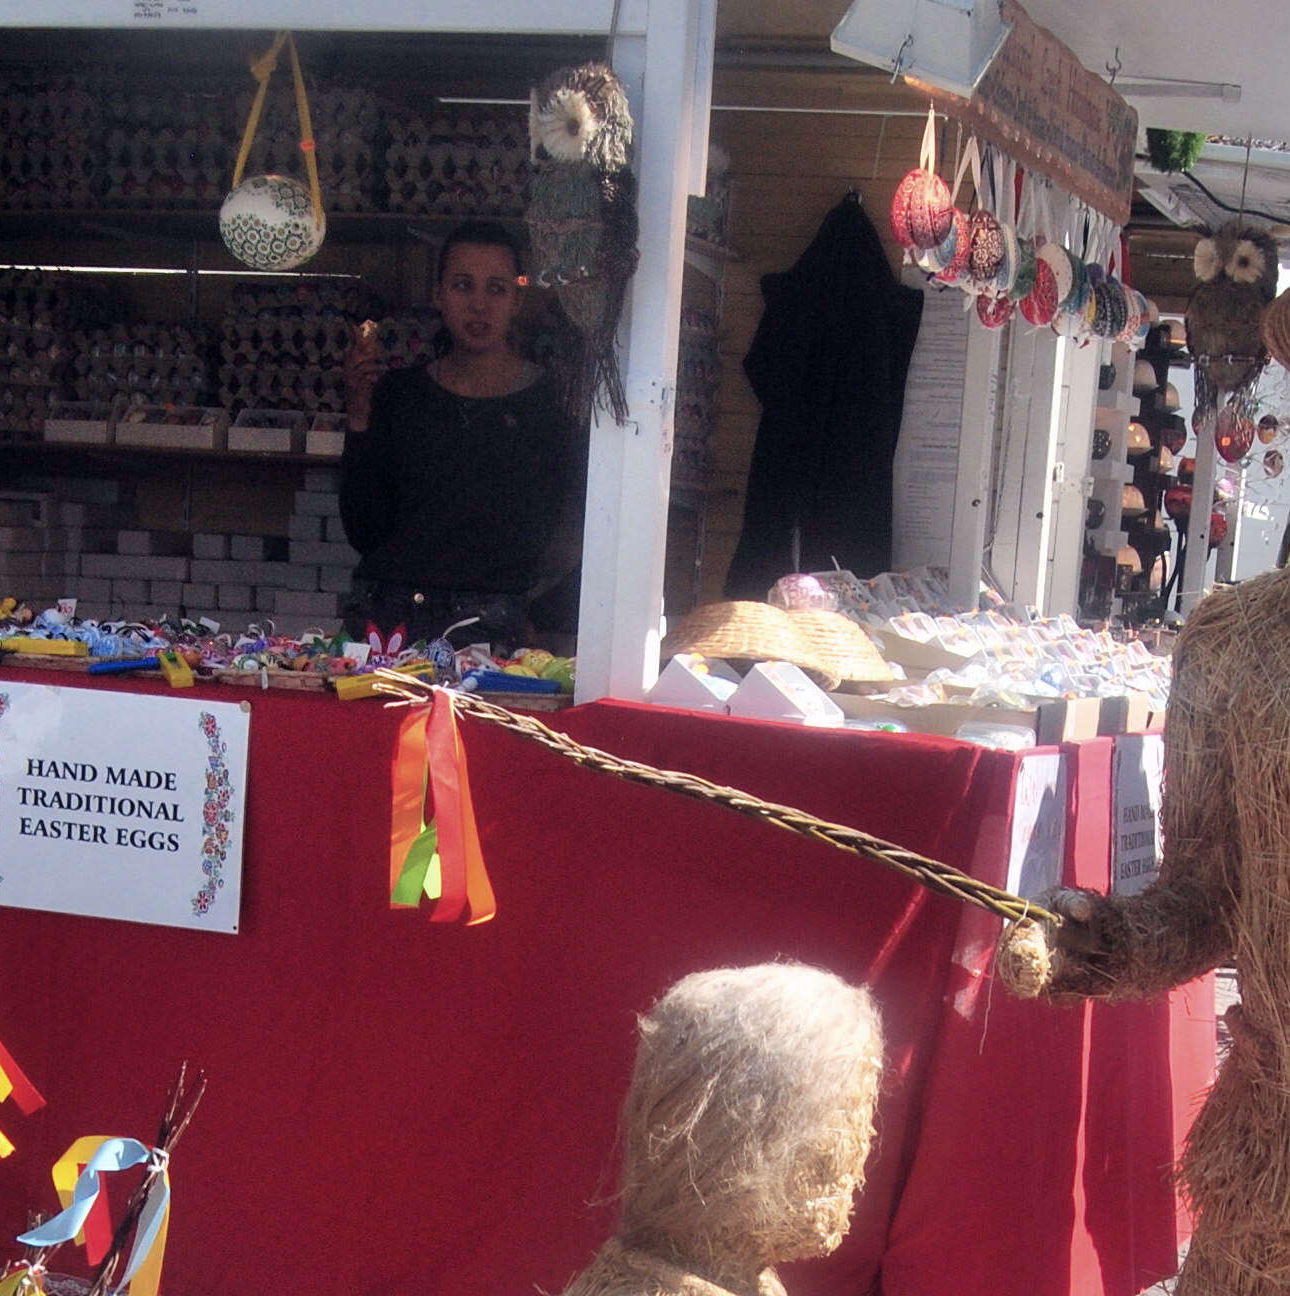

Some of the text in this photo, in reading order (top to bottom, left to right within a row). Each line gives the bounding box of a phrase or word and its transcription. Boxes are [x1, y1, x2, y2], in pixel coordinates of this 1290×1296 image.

[26, 758, 177, 791] HAND MADE
[17, 787, 185, 822] TRADITIONAL
[1123, 805, 1139, 823] HAND
[19, 817, 179, 852] EASTER EGGS
[1120, 859, 1141, 880] EASTER
